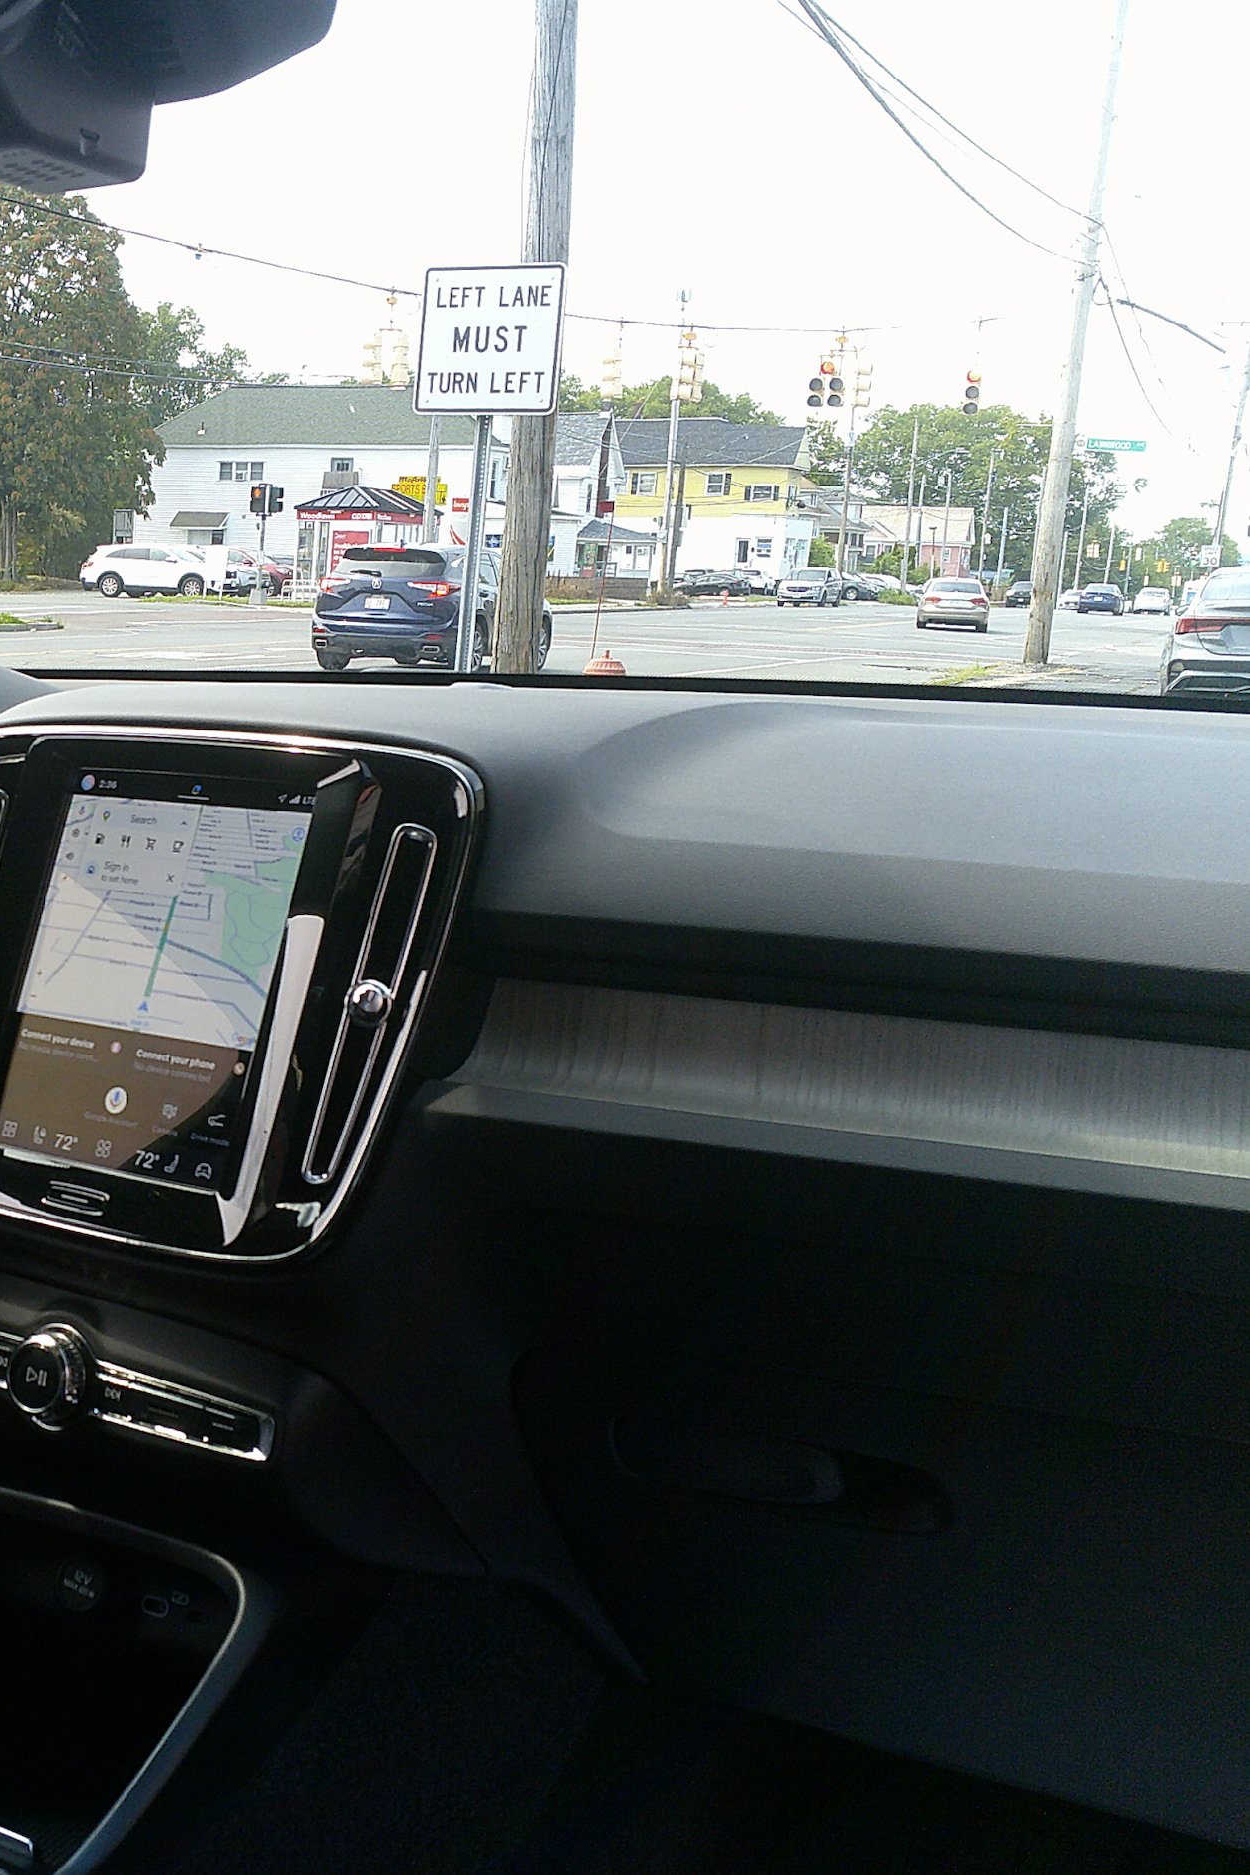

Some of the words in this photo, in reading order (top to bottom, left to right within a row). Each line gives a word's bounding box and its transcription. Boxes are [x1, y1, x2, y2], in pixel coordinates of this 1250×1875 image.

[436, 286, 486, 308] LEFT
[499, 285, 552, 307] LANE
[452, 325, 527, 353] MUST
[427, 372, 478, 394] TURN
[490, 371, 545, 394] LEFT
[1202, 557, 1218, 566] 30
[129, 814, 158, 825] Search
[103, 860, 122, 873] Sign
[122, 863, 130, 873] in
[120, 876, 140, 886] home
[21, 1028, 52, 1042] Connect
[52, 1035, 70, 1045] your
[69, 1037, 95, 1050] device
[135, 1048, 170, 1062] Connect
[170, 1055, 190, 1066] your
[188, 1058, 216, 1070] phone
